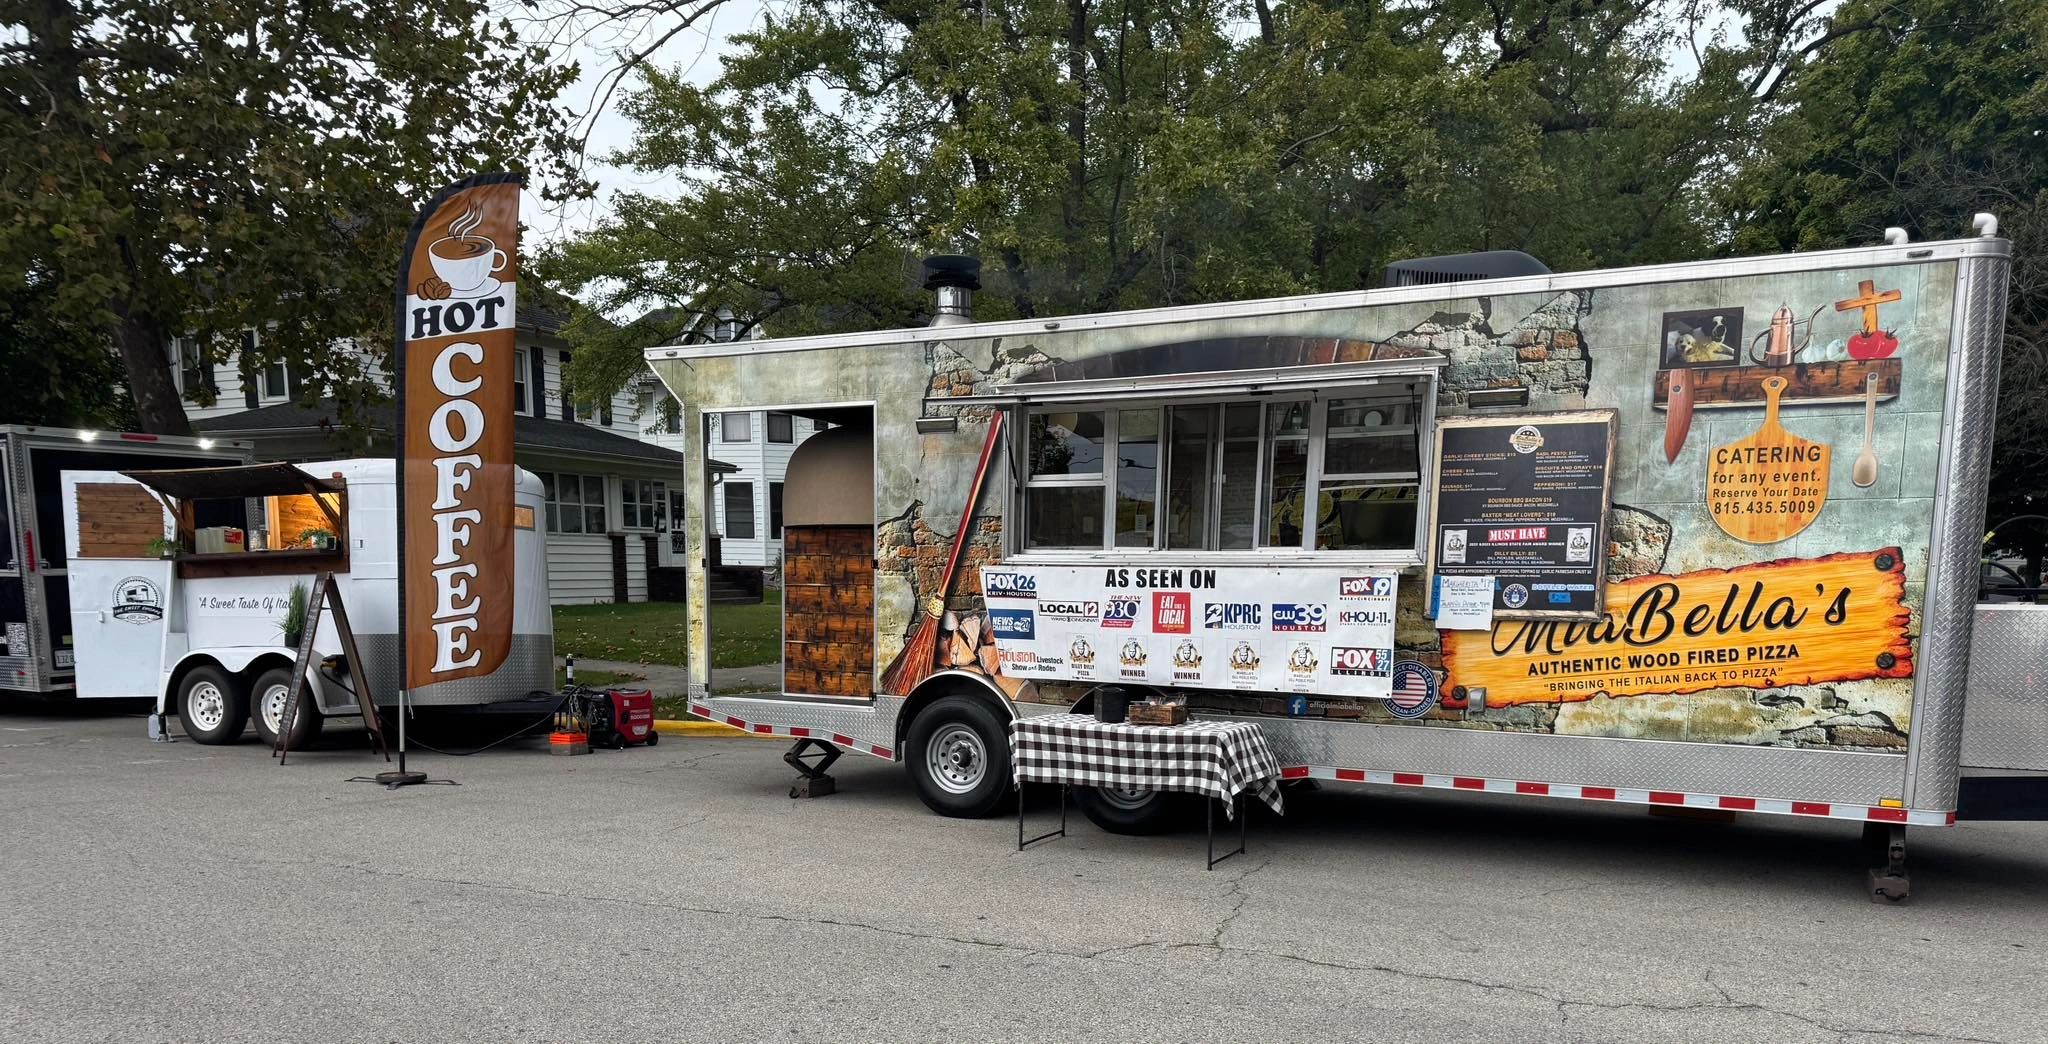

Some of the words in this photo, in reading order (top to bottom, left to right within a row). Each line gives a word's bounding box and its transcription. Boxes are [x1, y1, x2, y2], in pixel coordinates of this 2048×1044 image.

[411, 296, 505, 339] HOT
[1716, 446, 1821, 464] CATERING
[1713, 472, 1734, 484] for
[1740, 472, 1766, 486] any
[1774, 470, 1821, 482] event.
[1713, 488, 1758, 498] Reserve
[1762, 488, 1788, 497] Your
[1792, 487, 1818, 496] Date
[428, 342, 486, 673] COFFEE
[1714, 500, 1816, 514] 815.435.5009
[1488, 530, 1516, 541] MUST
[1519, 528, 1546, 540] HAVE
[986, 574, 1018, 590] FOX
[1018, 576, 1036, 590] 26
[1105, 569, 1130, 588] AS
[1136, 569, 1183, 588] SEEN
[1190, 569, 1216, 589] ON
[1342, 578, 1372, 594] FOX
[1374, 578, 1390, 596] 19
[210, 597, 236, 609] Sweet
[238, 597, 260, 609] Taste
[262, 597, 274, 614] Of
[276, 597, 293, 609] Ital
[1040, 604, 1083, 614] LOCAL
[1084, 602, 1098, 617] 12
[1161, 596, 1176, 609] EAT
[992, 616, 1014, 625] NEWS
[1158, 610, 1186, 625] LOCAL
[1224, 604, 1262, 624] KPRC
[1294, 604, 1326, 625] 39
[1492, 581, 1853, 657] MiaBella's
[1036, 656, 1064, 664] Livestock
[1332, 648, 1374, 669] FOX
[1376, 649, 1388, 660] 55
[1528, 656, 1622, 676] AUTHENTIC
[1628, 652, 1681, 668] WOOD
[1688, 648, 1740, 665] FIRED
[1746, 644, 1800, 661] PIZZA
[1120, 669, 1146, 678] WINNER
[1377, 660, 1390, 671] 27
[1174, 672, 1200, 680] WINNER
[1392, 664, 1433, 687] ICE-DISABLED
[1544, 678, 1605, 692] "BRINGING
[1610, 676, 1630, 687] THE
[1635, 674, 1680, 686] ITALIAN
[1685, 672, 1718, 682] BACK
[1722, 670, 1738, 680] TO
[1742, 666, 1784, 679] PIZZA"
[1386, 698, 1432, 714] ETERAN-OWNED
